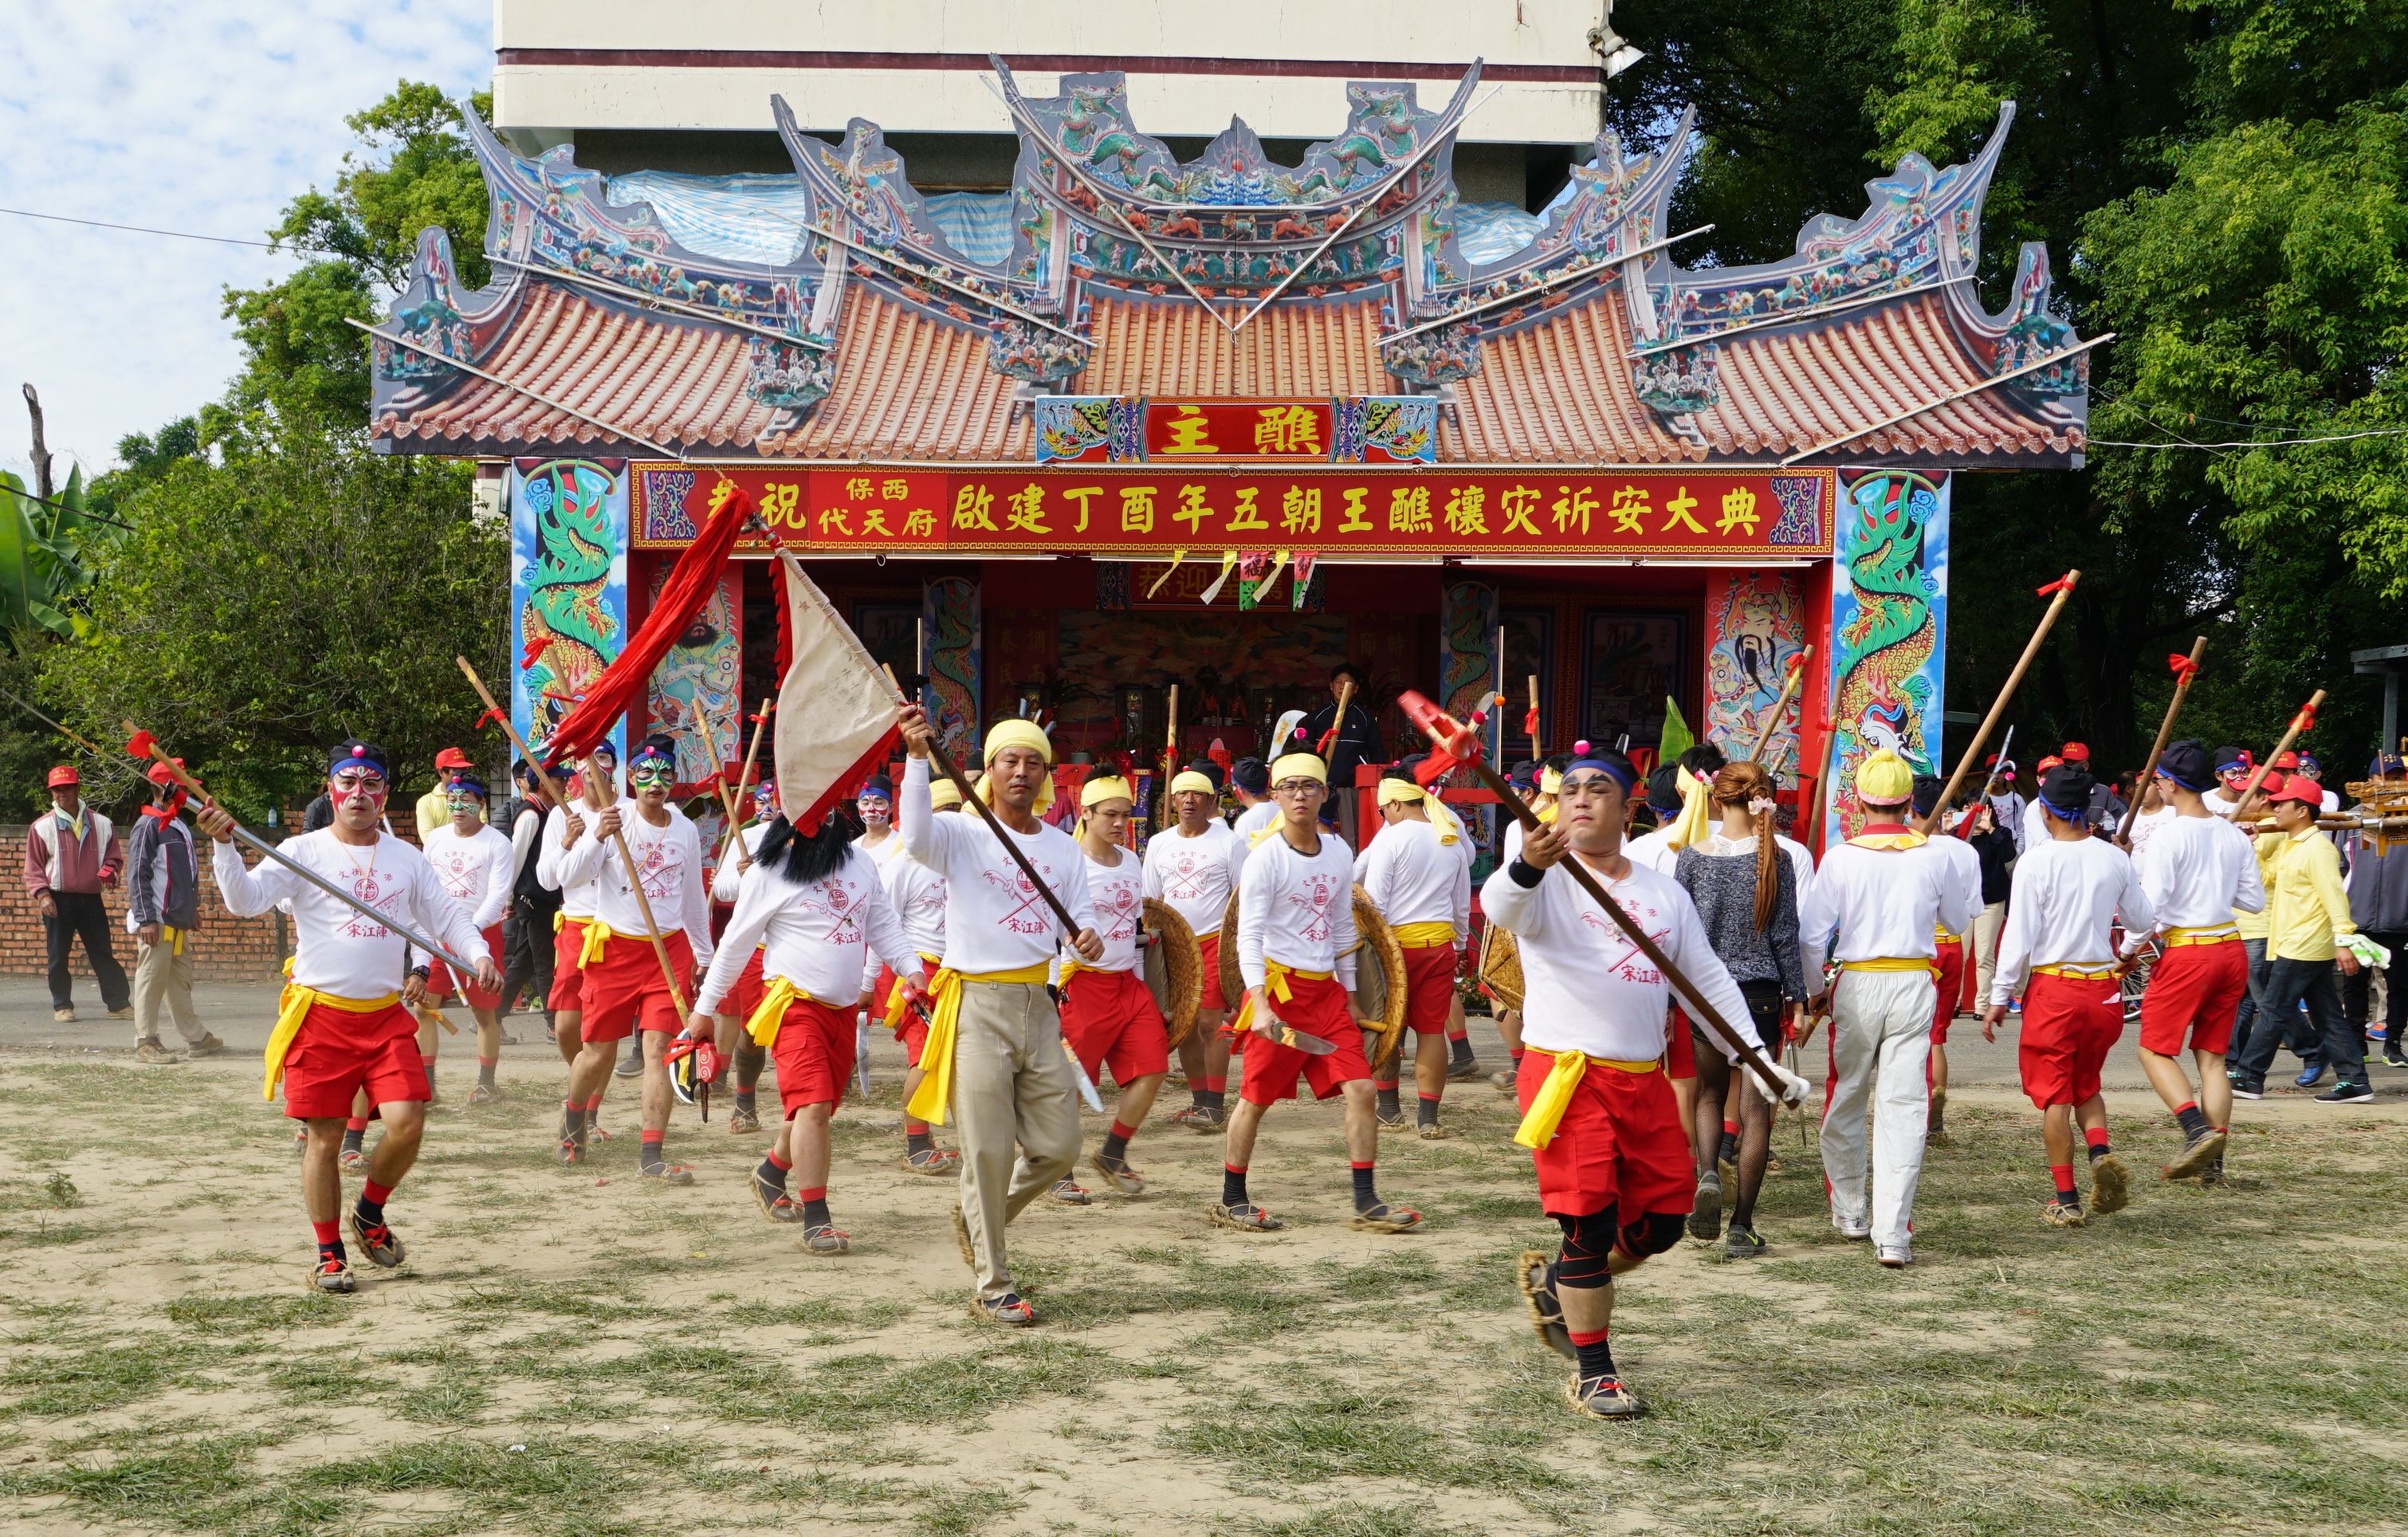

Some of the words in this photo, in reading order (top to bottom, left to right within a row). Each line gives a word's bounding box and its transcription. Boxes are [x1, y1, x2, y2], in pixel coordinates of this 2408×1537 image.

[1161, 405, 1322, 455] 主醮
[846, 478, 909, 501] 保西
[818, 508, 938, 537] 代天府
[1008, 918, 1044, 936] 宋江陣
